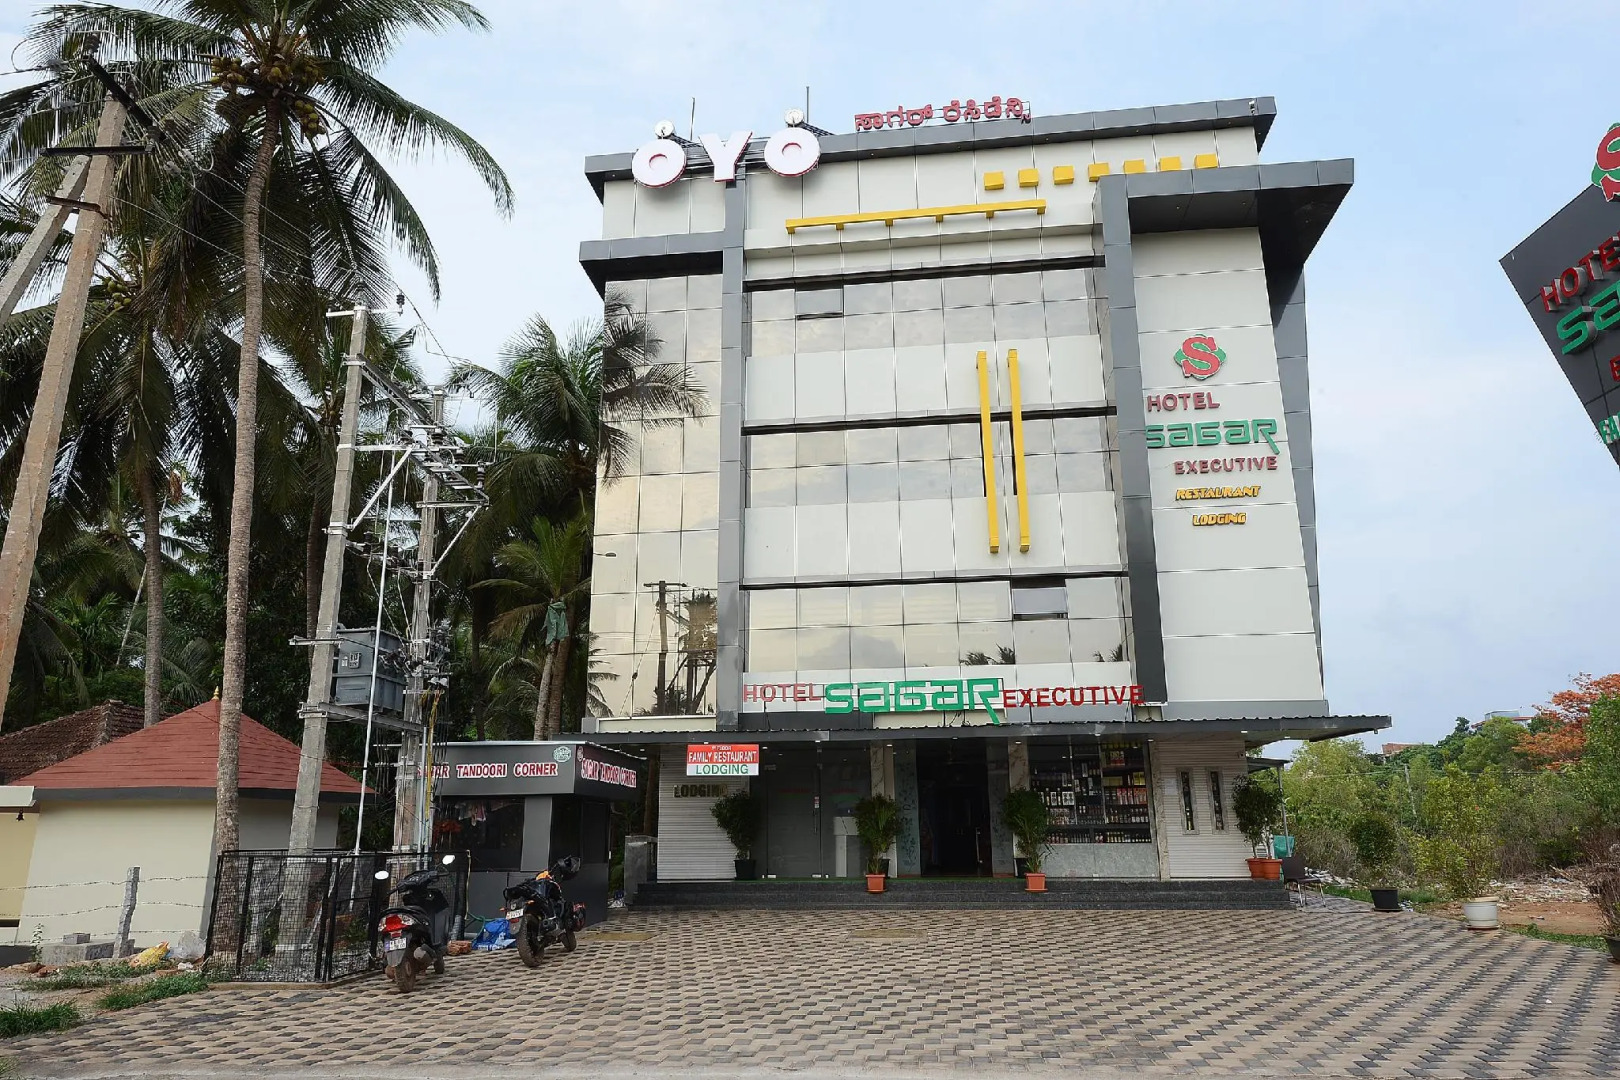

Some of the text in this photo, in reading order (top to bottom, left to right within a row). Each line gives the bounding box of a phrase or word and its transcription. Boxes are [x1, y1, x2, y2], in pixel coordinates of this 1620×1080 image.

[631, 127, 821, 188] OYO
[1541, 229, 1620, 313] HOTE
[1147, 391, 1220, 412] HOTEL
[1174, 456, 1278, 475] EXECUTIVE
[1176, 485, 1261, 501] RESTAURANT
[1192, 512, 1247, 526] LODGING
[743, 683, 822, 703] HOTEL
[1003, 685, 1144, 708] EXECUTIVE
[688, 751, 757, 763] FAMILY RESTAURANT
[456, 763, 507, 778] TANDOORI
[513, 762, 558, 777] CORNER
[695, 764, 749, 775] LODGING
